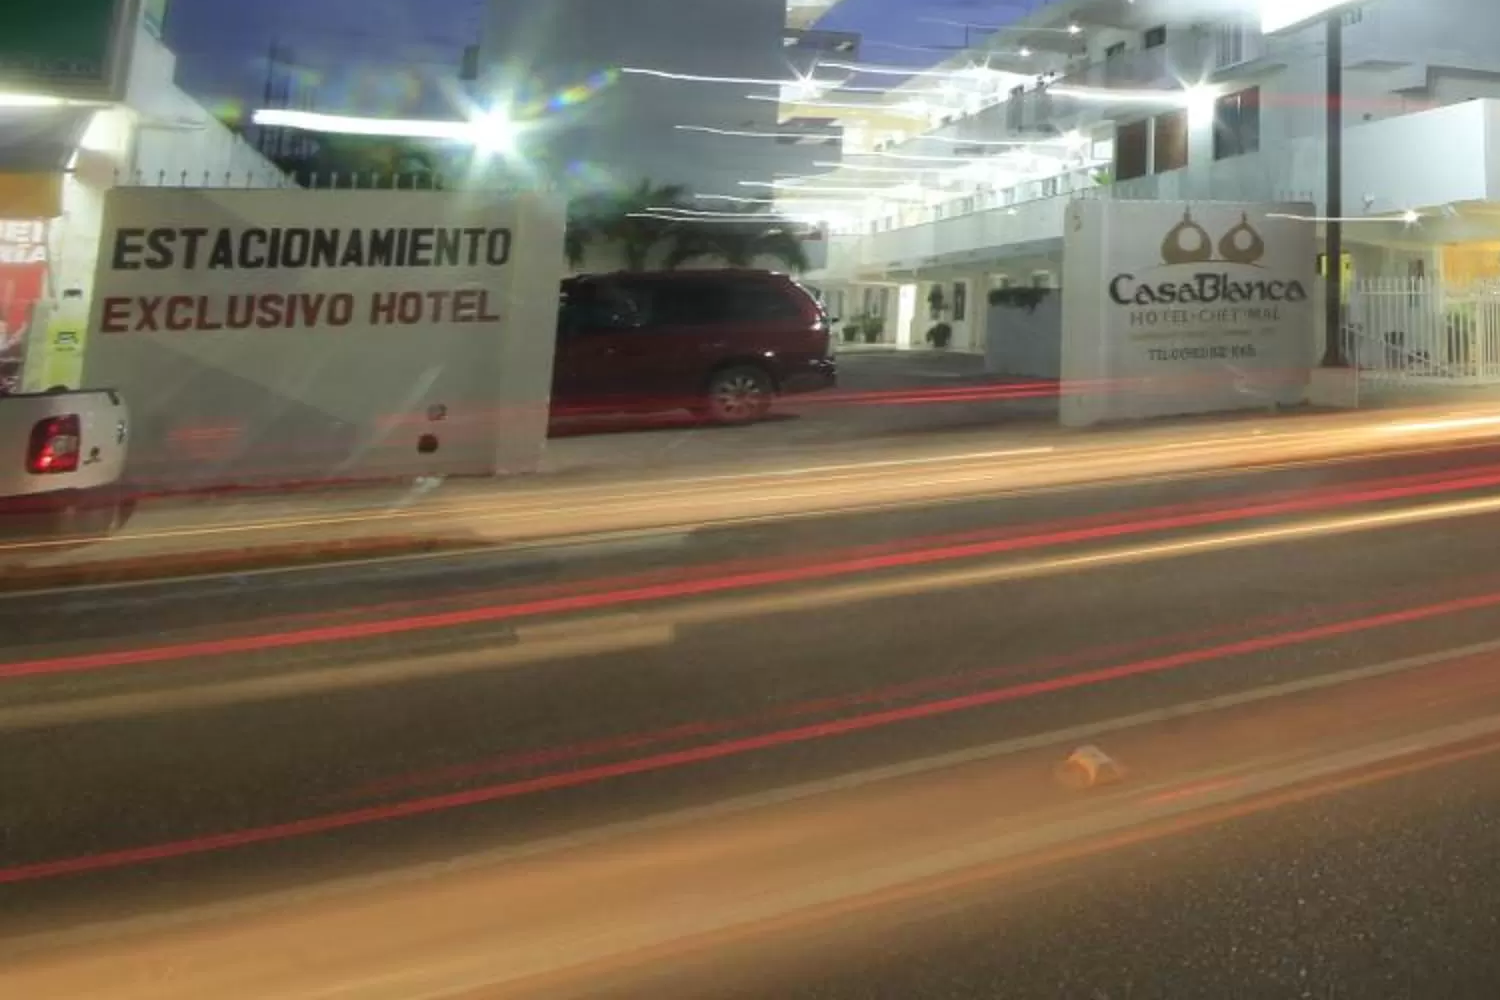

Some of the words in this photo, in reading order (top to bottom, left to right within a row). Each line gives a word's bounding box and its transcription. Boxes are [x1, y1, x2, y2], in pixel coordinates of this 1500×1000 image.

[112, 227, 511, 270] ESTACIONAMIENTO
[1109, 273, 1306, 305] CasaBlanca
[102, 292, 354, 333] EXCLUSIVO
[369, 289, 501, 325] HOTEL
